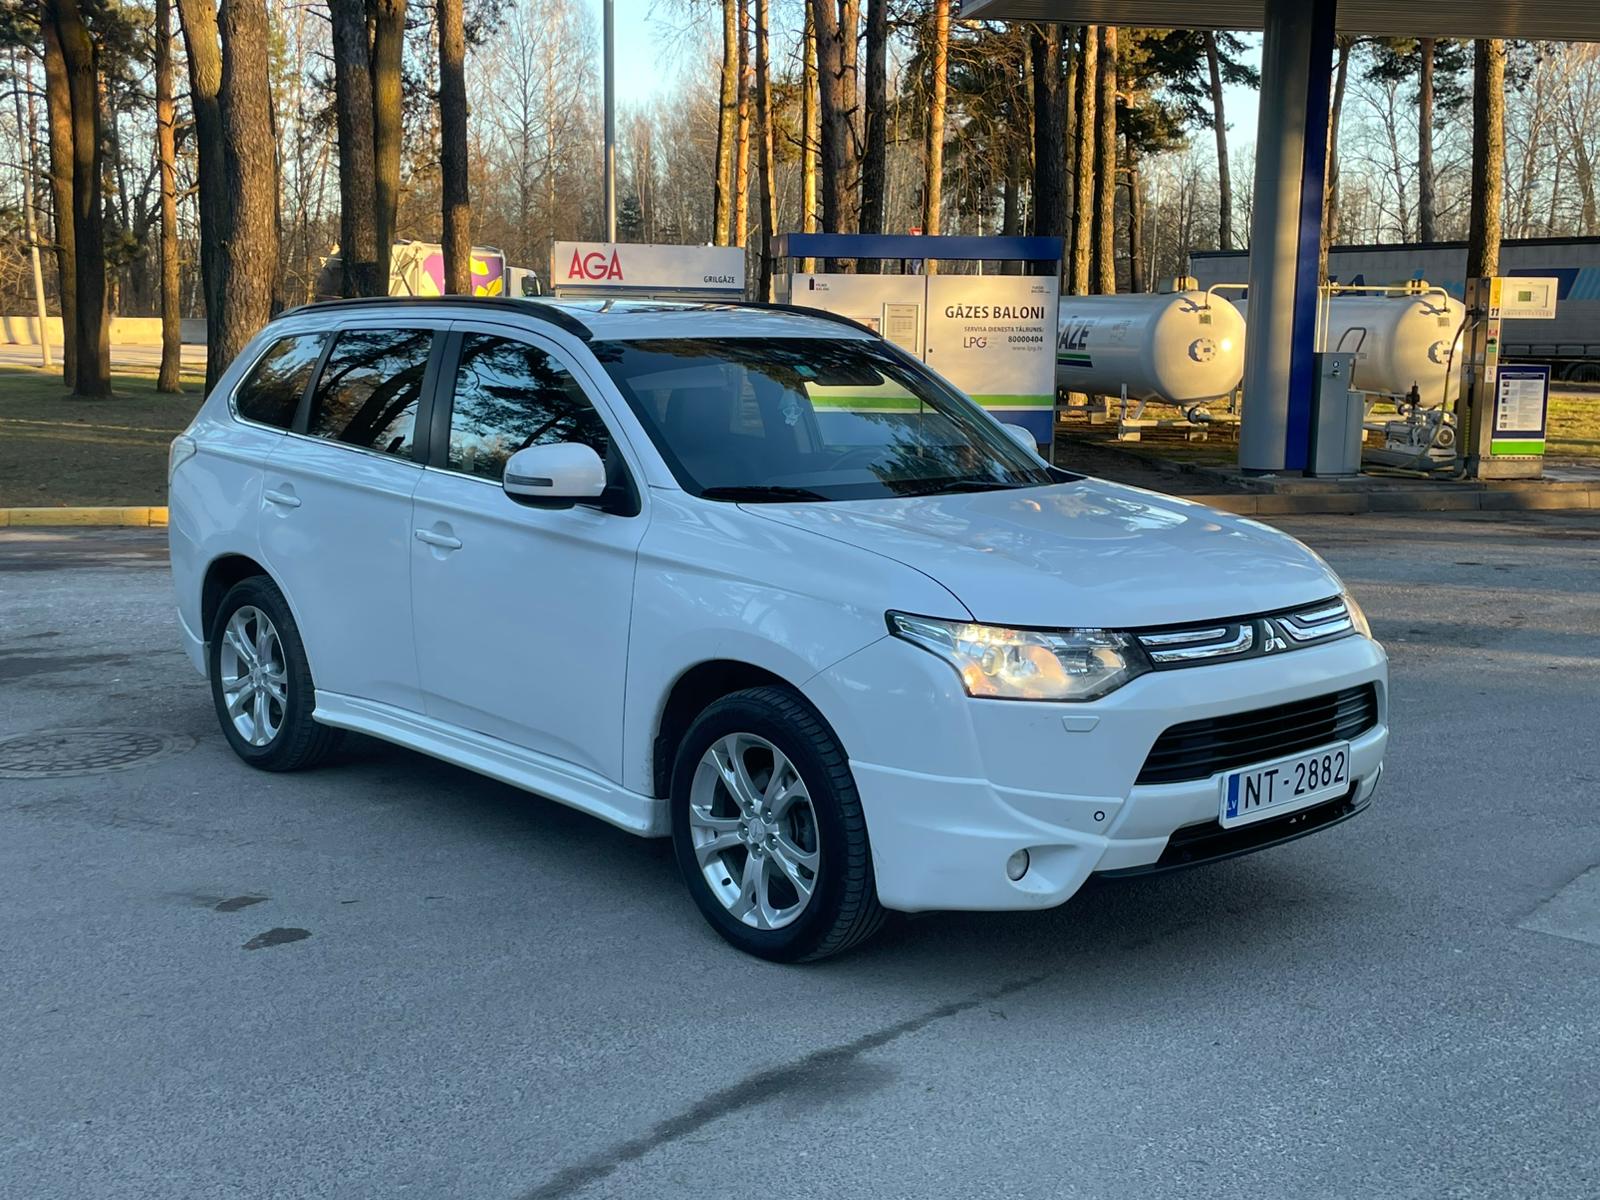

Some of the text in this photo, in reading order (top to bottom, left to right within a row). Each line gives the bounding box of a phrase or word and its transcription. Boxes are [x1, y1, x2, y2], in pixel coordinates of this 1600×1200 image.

[568, 247, 624, 281] AGA
[703, 275, 736, 284] GRILGĀZE
[945, 303, 1045, 319] GĀZES BALONI
[963, 336, 987, 349] LPG
